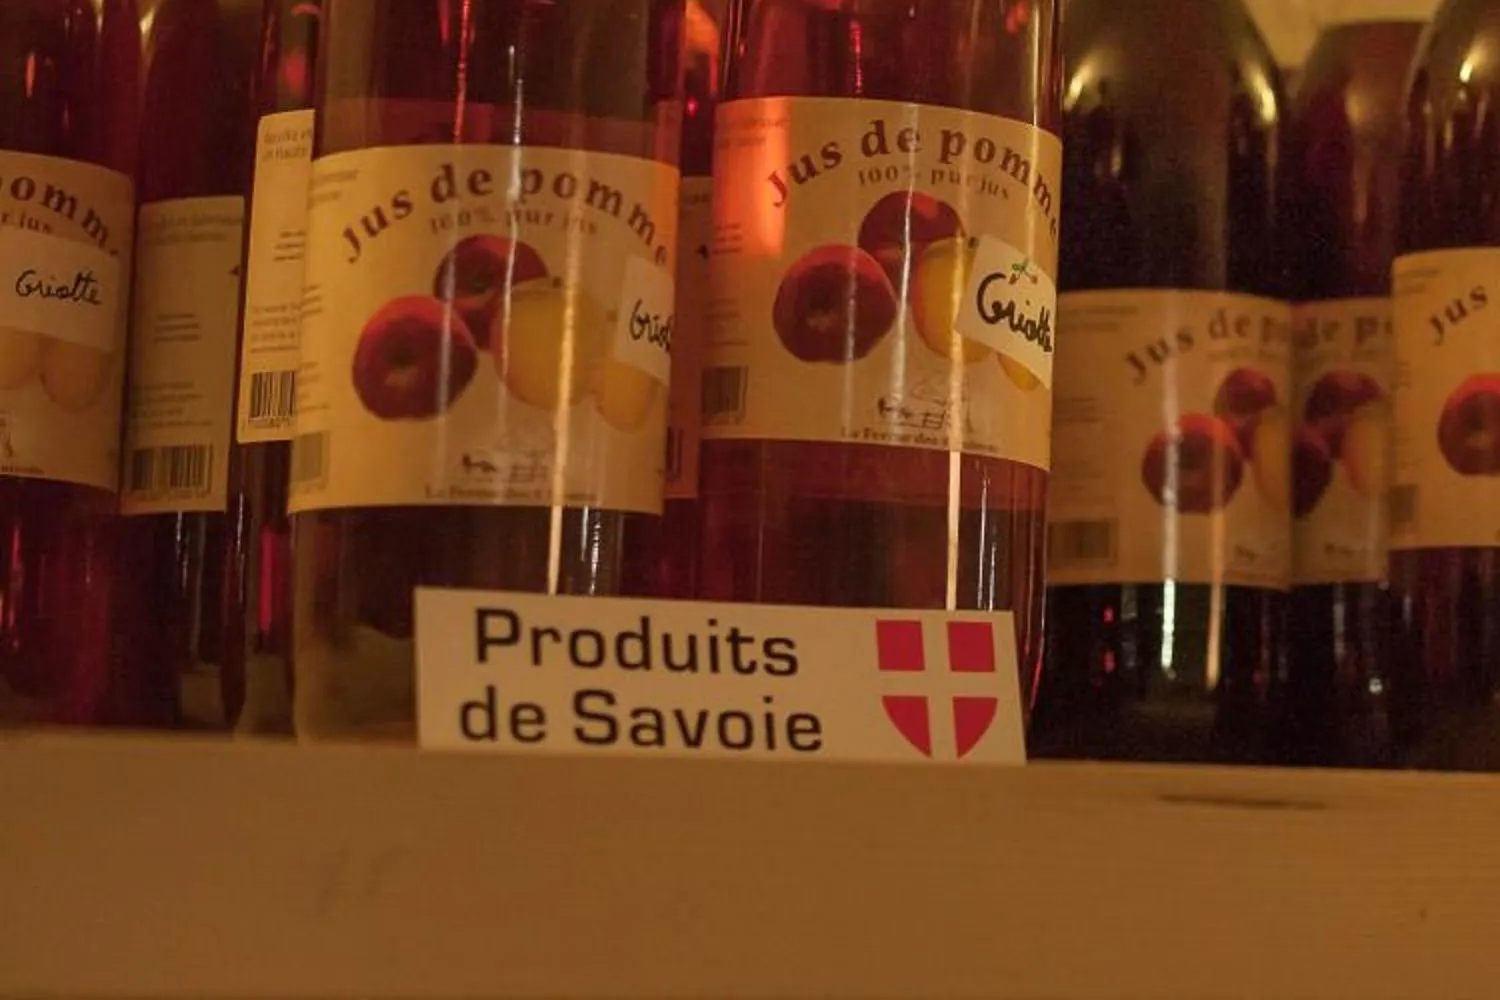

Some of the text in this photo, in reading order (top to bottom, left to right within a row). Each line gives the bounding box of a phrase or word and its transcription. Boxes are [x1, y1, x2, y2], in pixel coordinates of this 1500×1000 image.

[861, 119, 922, 158] de
[0, 175, 120, 257] omm
[430, 163, 493, 202] de
[475, 607, 800, 678] Produits
[460, 684, 824, 753] de Savoie
